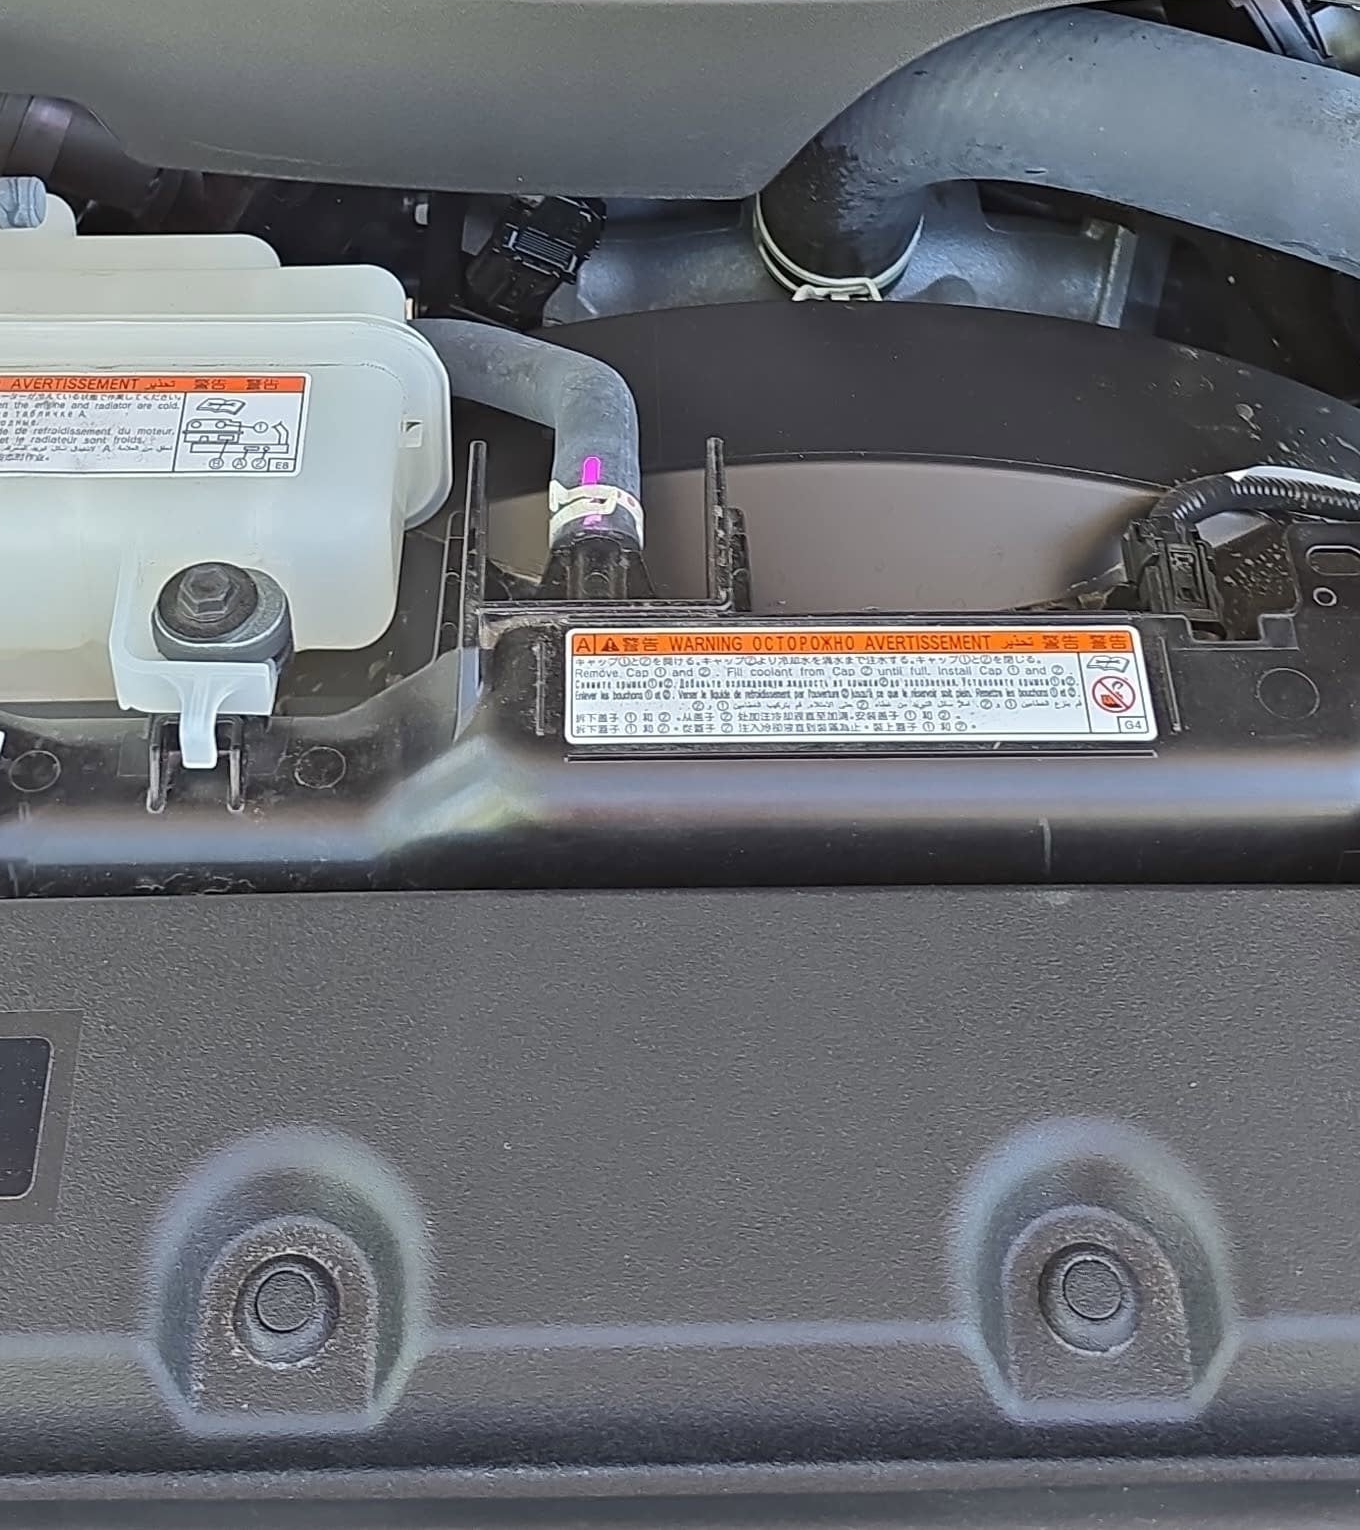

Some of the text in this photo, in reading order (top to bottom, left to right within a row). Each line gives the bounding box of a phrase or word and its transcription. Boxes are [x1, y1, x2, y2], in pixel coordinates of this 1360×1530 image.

[11, 378, 140, 390] AVERTISSEMENT
[15, 427, 28, 435] de
[33, 427, 111, 435] refroidissement
[31, 436, 77, 444] radiateur
[275, 461, 289, 470] E8
[576, 638, 591, 653] A
[669, 637, 743, 652] WARNING
[753, 637, 855, 651] ОСТОРОЖНО
[865, 635, 991, 650] AVERTISSEMENT
[575, 669, 619, 678] Remove
[626, 669, 649, 679] Cap
[672, 668, 694, 677] and
[728, 668, 743, 677] Fill
[751, 668, 793, 676] coolant
[800, 667, 825, 676] from
[832, 667, 856, 677] Cap
[878, 666, 903, 676] until
[910, 666, 930, 676] full.
[938, 666, 972, 676] Install
[980, 666, 1003, 677] Cap
[1025, 666, 1047, 676] and
[1125, 721, 1142, 730] G4
